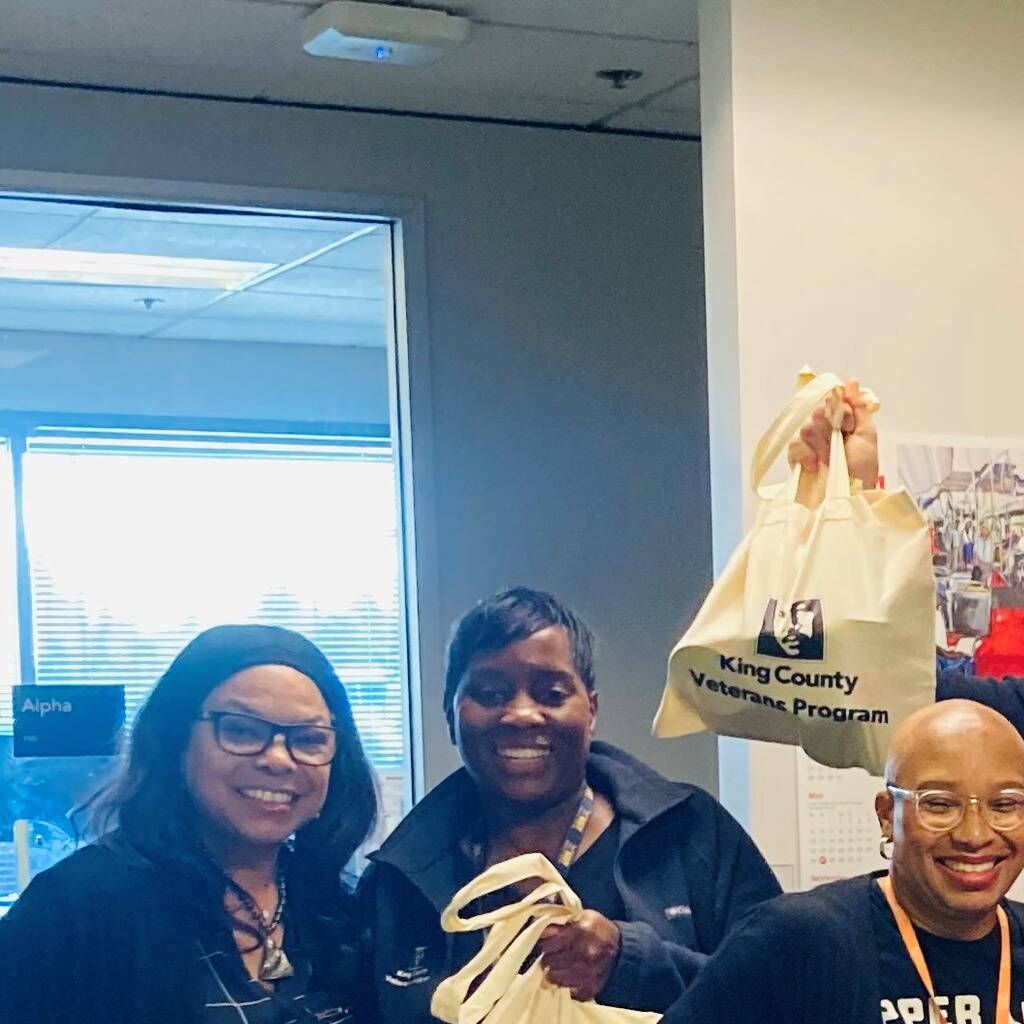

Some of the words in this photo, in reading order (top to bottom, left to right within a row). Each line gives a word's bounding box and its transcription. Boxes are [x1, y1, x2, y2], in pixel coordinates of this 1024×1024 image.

[720, 654, 770, 685] King
[774, 665, 859, 695] County
[21, 698, 72, 718] Alpha
[688, 668, 787, 712] Veterans
[792, 698, 889, 724] Program
